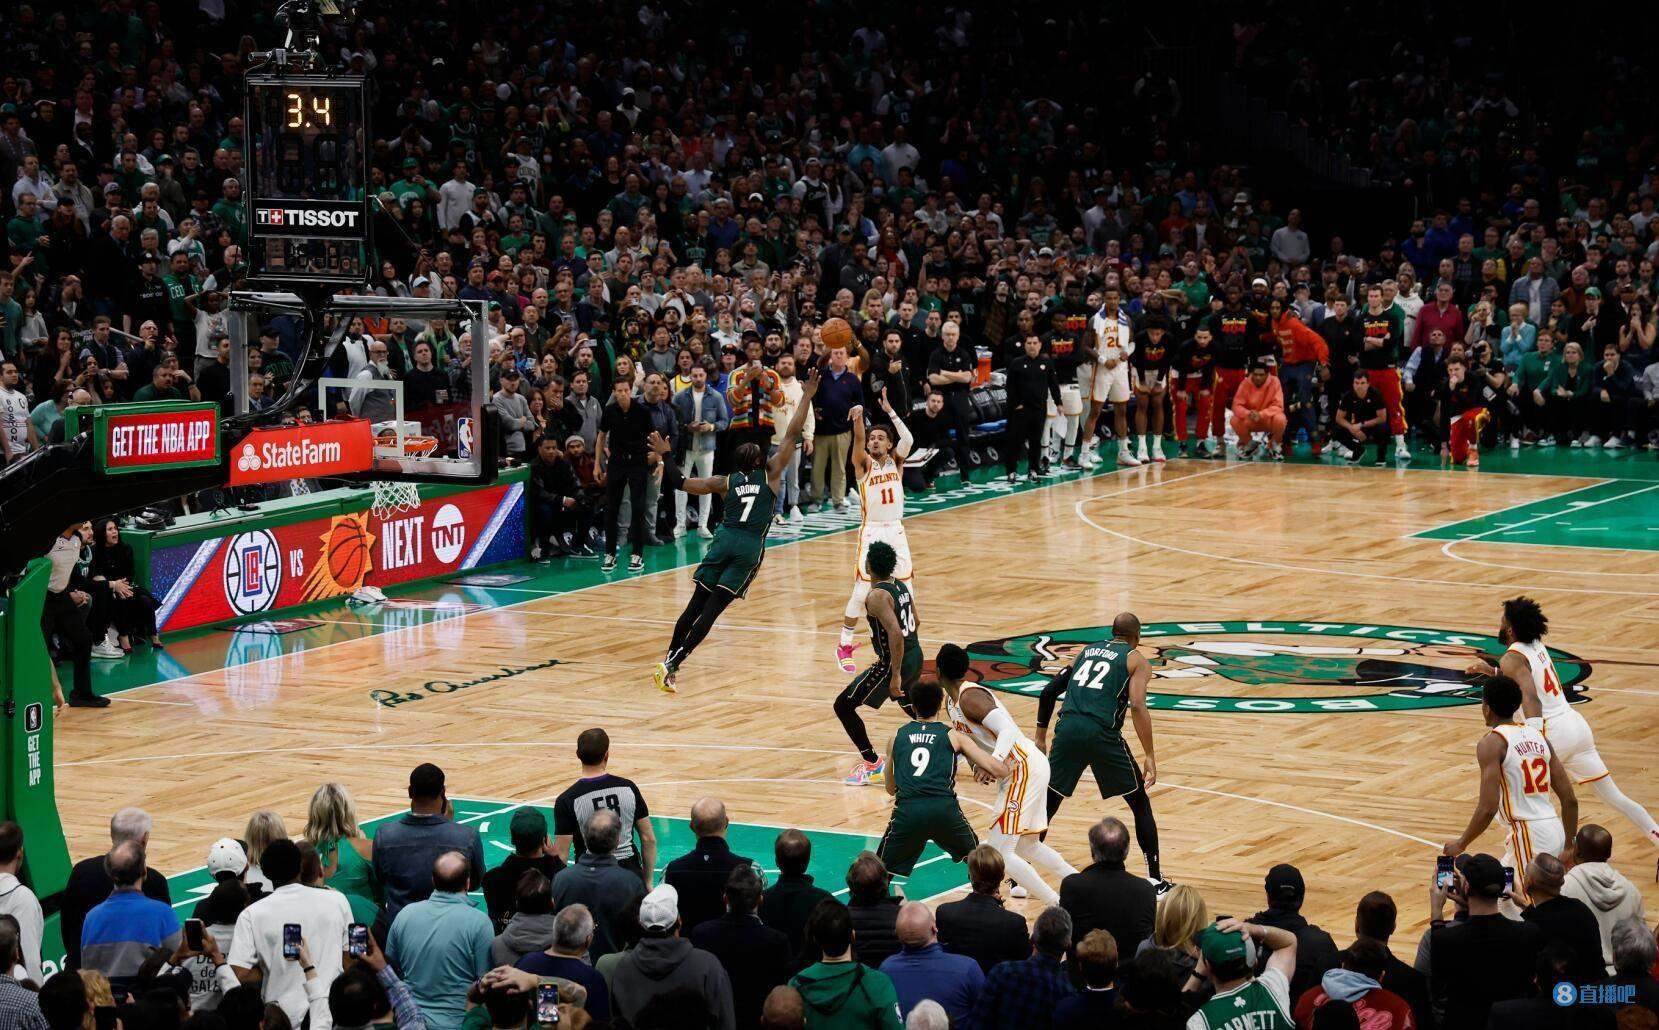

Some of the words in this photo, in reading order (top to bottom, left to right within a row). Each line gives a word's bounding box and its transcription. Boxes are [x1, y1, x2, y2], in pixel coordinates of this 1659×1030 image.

[287, 93, 330, 128] 3.4
[284, 209, 359, 227] TISSOT
[112, 424, 135, 458] GET
[137, 423, 159, 456] THE
[161, 421, 185, 454] NBA
[187, 420, 210, 451] APP
[869, 472, 899, 487] ATLANTA
[735, 484, 761, 497] BROWN
[880, 487, 895, 505] 11
[740, 496, 756, 522] 7
[290, 549, 304, 578] VS
[382, 516, 425, 571] NEXT
[900, 604, 916, 638] 36
[1084, 647, 1119, 662] HORFORD
[1073, 659, 1111, 690] 42
[28, 734, 40, 752] GET
[908, 733, 937, 745] WHITE
[1514, 738, 1546, 757] HUNTER
[28, 751, 41, 769] THE
[910, 746, 931, 777] 9
[29, 767, 41, 787] APP
[1520, 757, 1549, 795] 12
